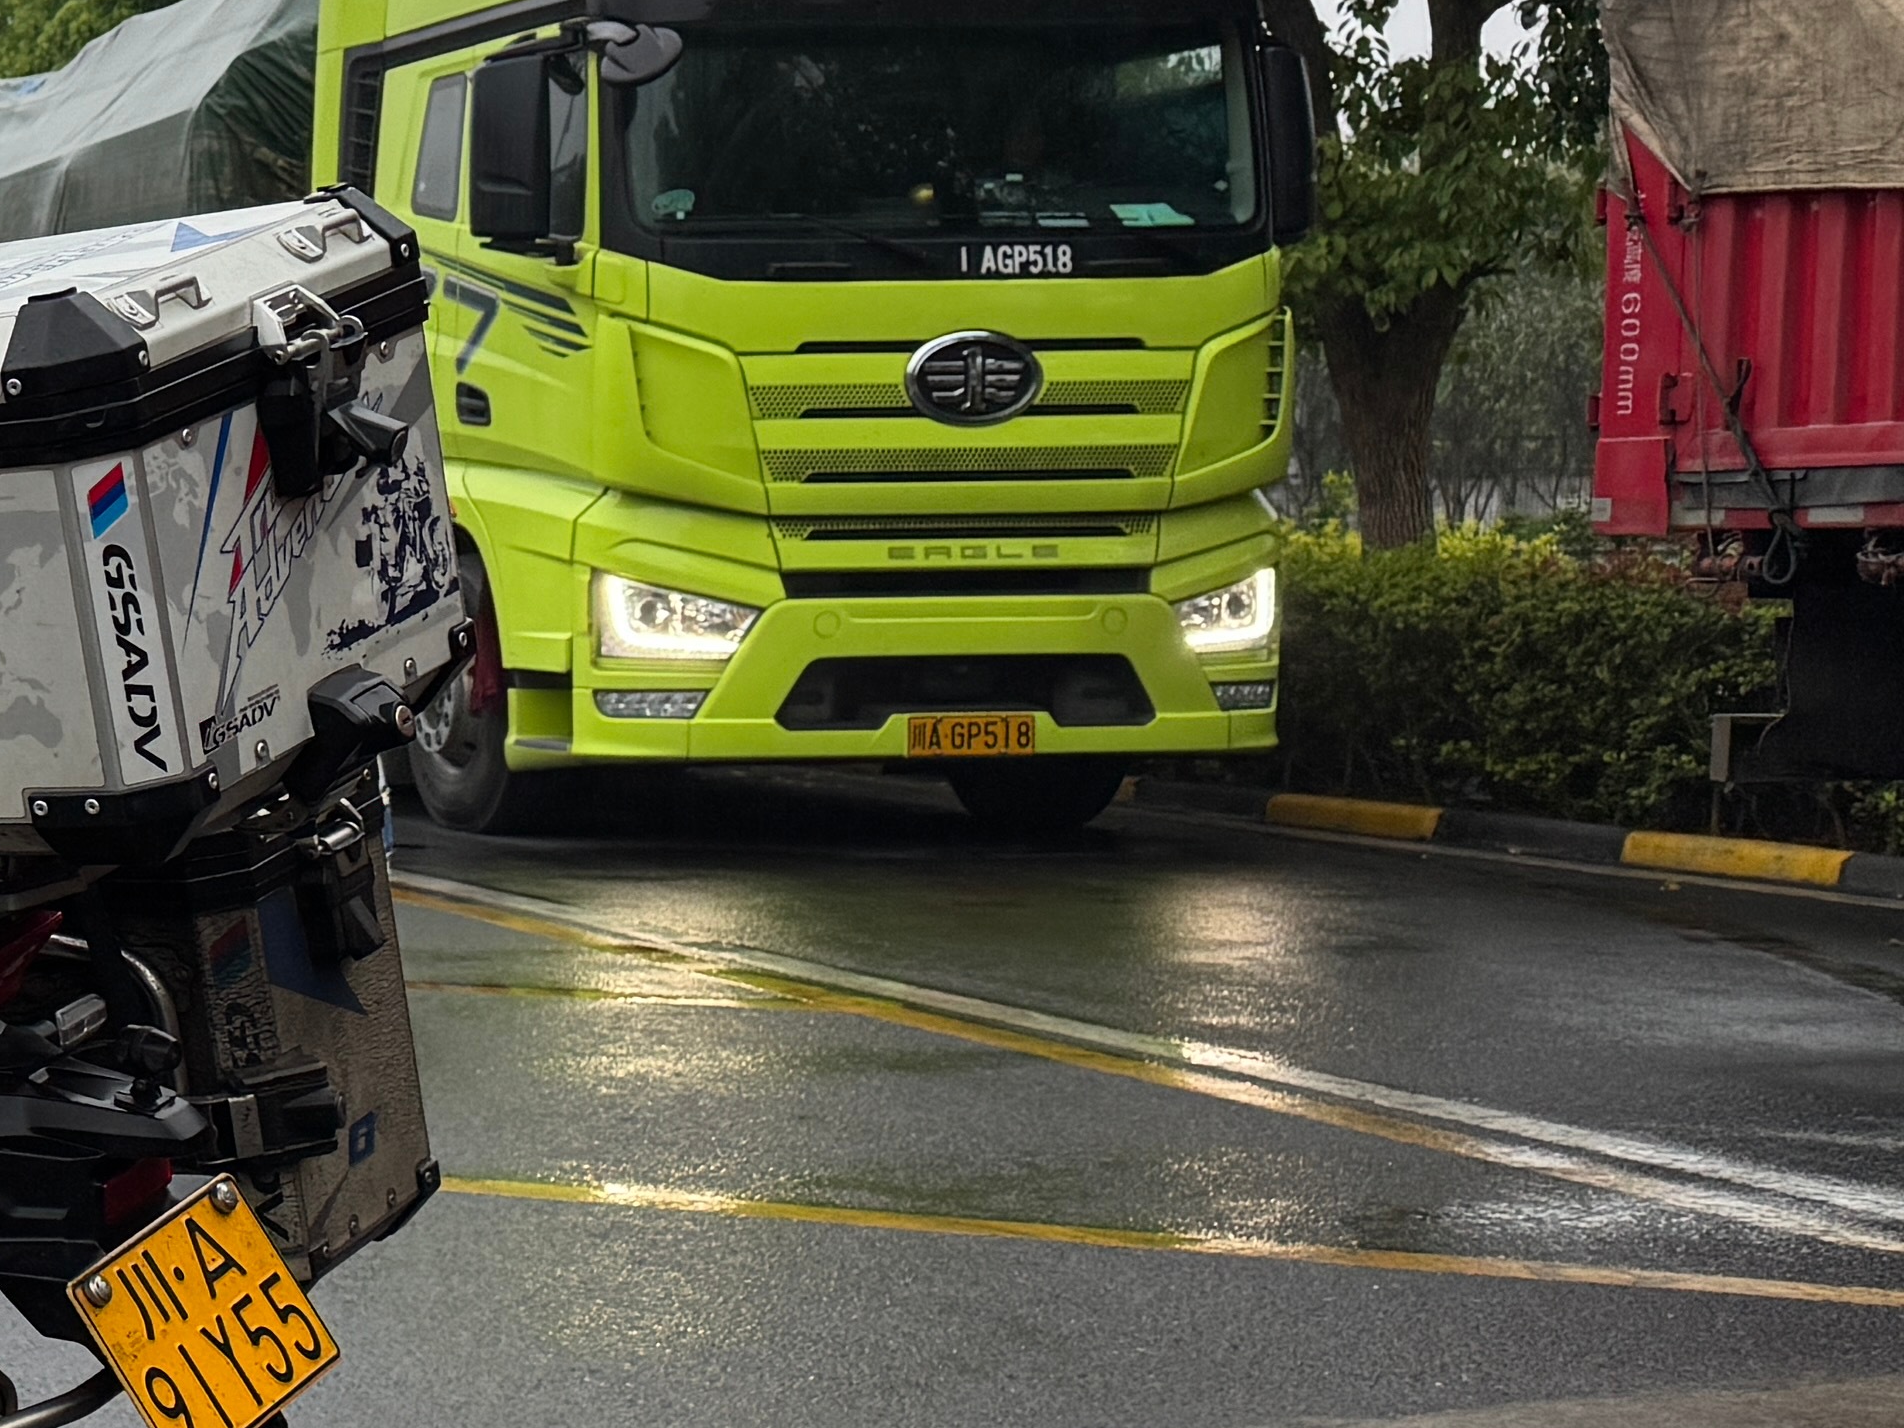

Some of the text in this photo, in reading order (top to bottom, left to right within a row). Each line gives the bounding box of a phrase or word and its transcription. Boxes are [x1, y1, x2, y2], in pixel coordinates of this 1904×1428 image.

[981, 244, 1072, 274] AGP518
[1617, 293, 1641, 415] 600mm
[887, 544, 1059, 560] EAGLE
[102, 543, 168, 773] GSADV
